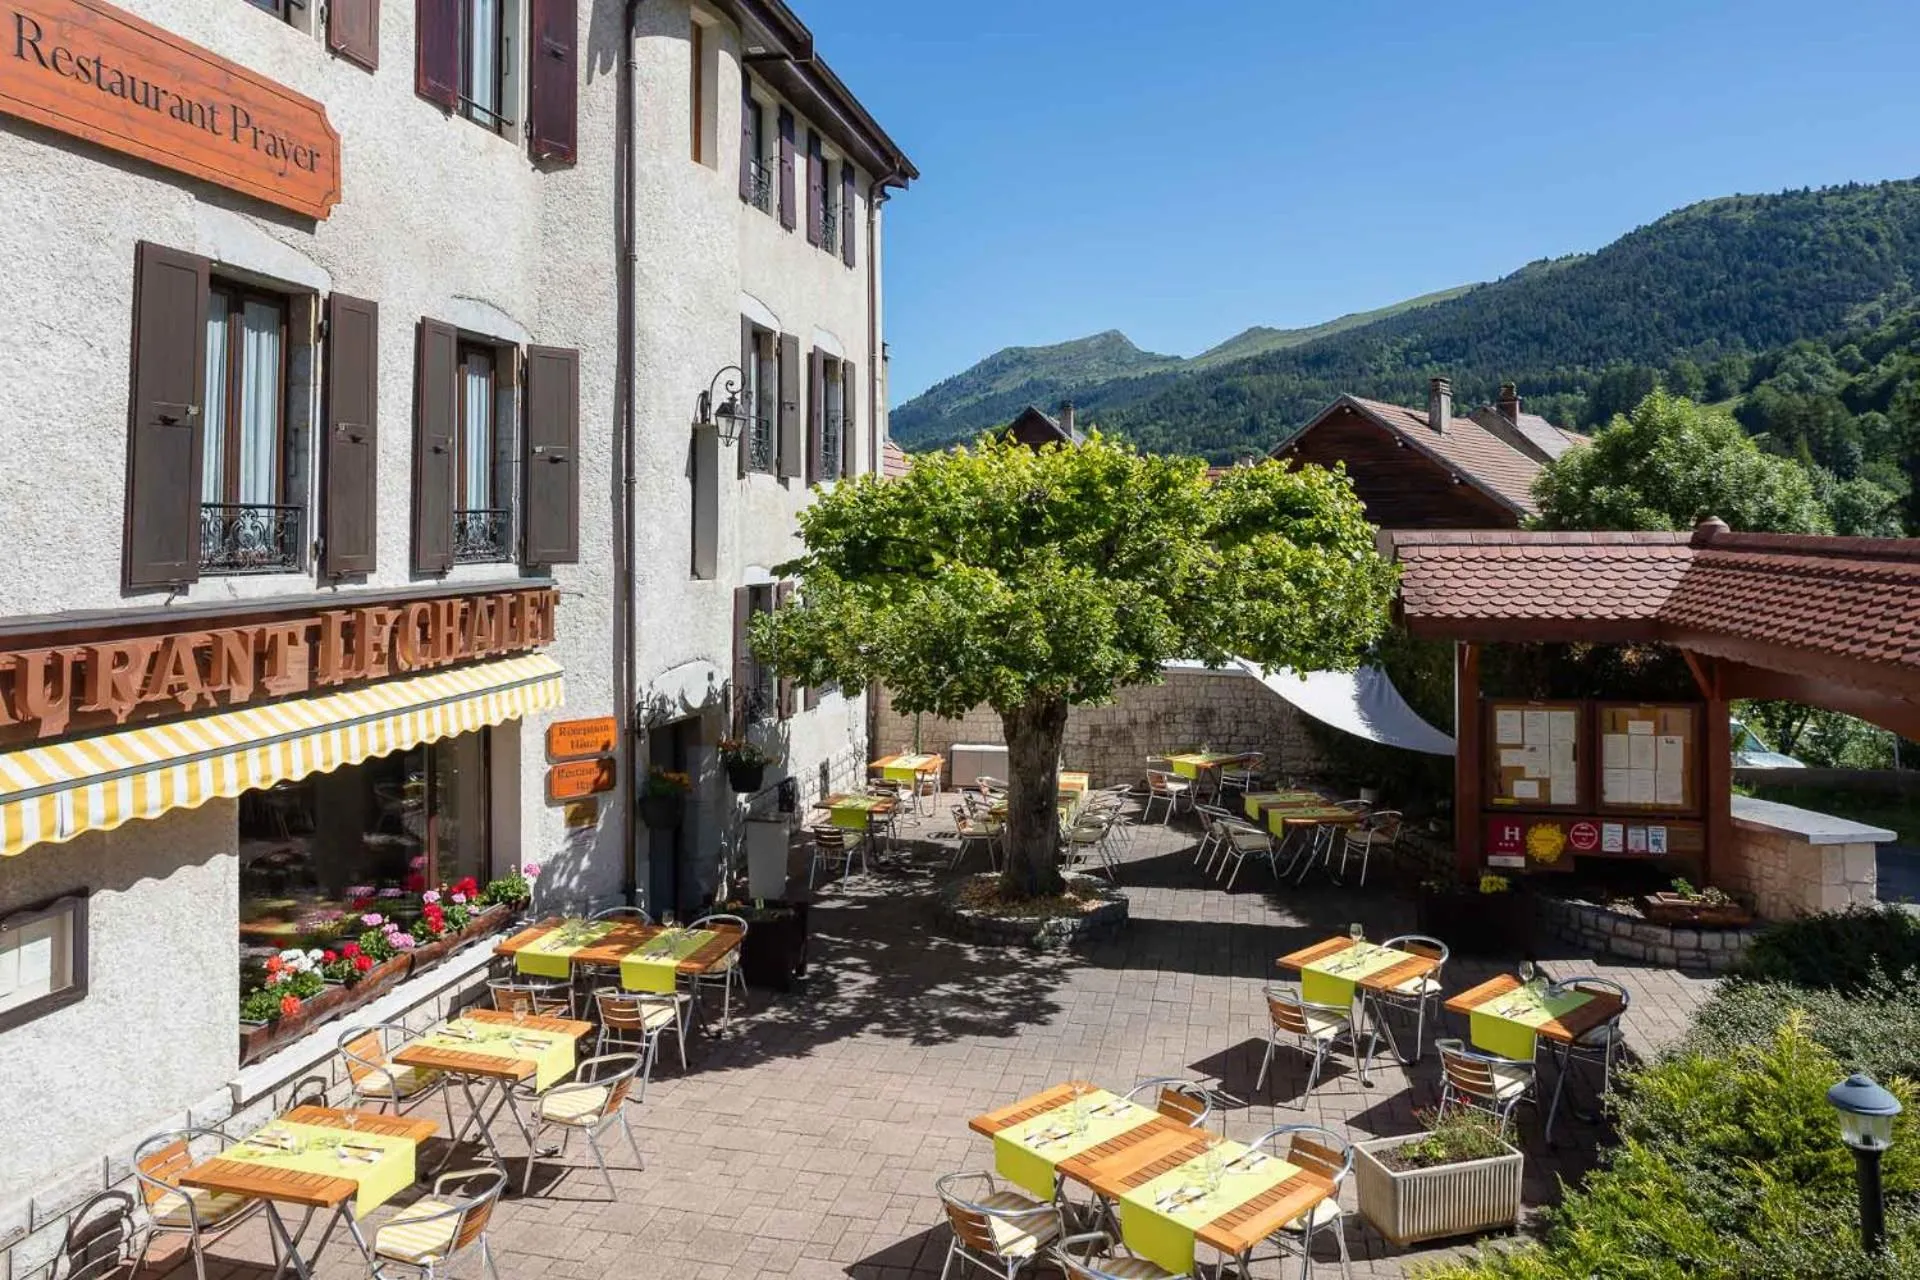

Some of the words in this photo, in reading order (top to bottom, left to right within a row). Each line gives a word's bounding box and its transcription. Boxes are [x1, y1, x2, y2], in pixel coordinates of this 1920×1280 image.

[12, 12, 224, 136] Restaurant
[230, 103, 321, 177] Prayer
[319, 607, 402, 685] LE
[403, 592, 559, 672] CHALET
[1504, 826, 1520, 841] H
